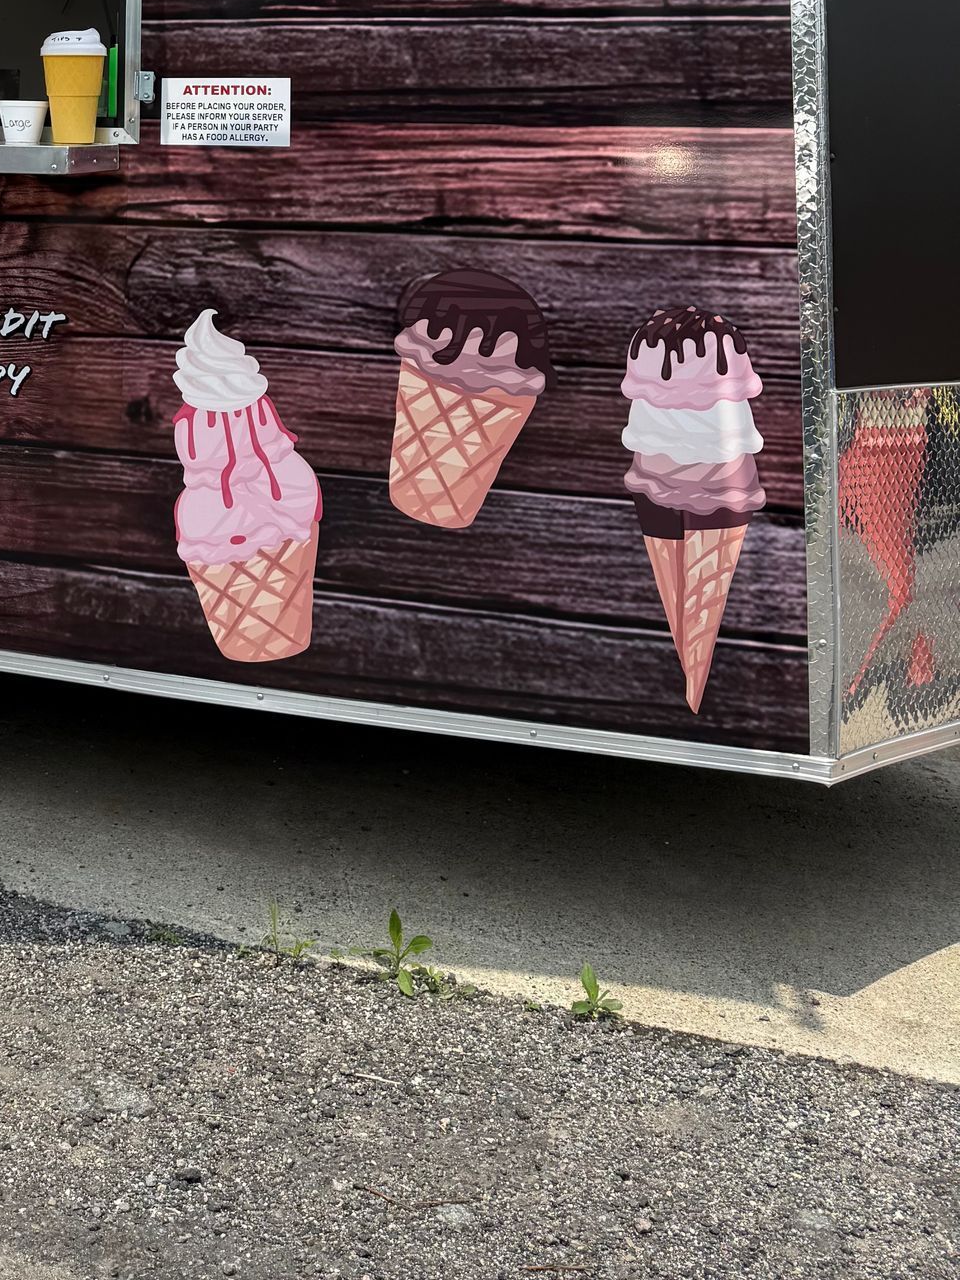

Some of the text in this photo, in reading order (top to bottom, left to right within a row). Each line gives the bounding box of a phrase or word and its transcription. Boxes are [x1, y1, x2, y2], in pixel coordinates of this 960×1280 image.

[183, 85, 272, 96] ATTENTION:
[166, 102, 196, 110] BEFORE
[257, 103, 286, 112] ORDER,
[166, 112, 195, 120] PLEASE
[252, 113, 283, 121] SERVER
[4, 115, 32, 131] Large
[230, 123, 251, 131] YOUR
[182, 133, 197, 141] HAS
[230, 134, 268, 142] ALLERGY.
